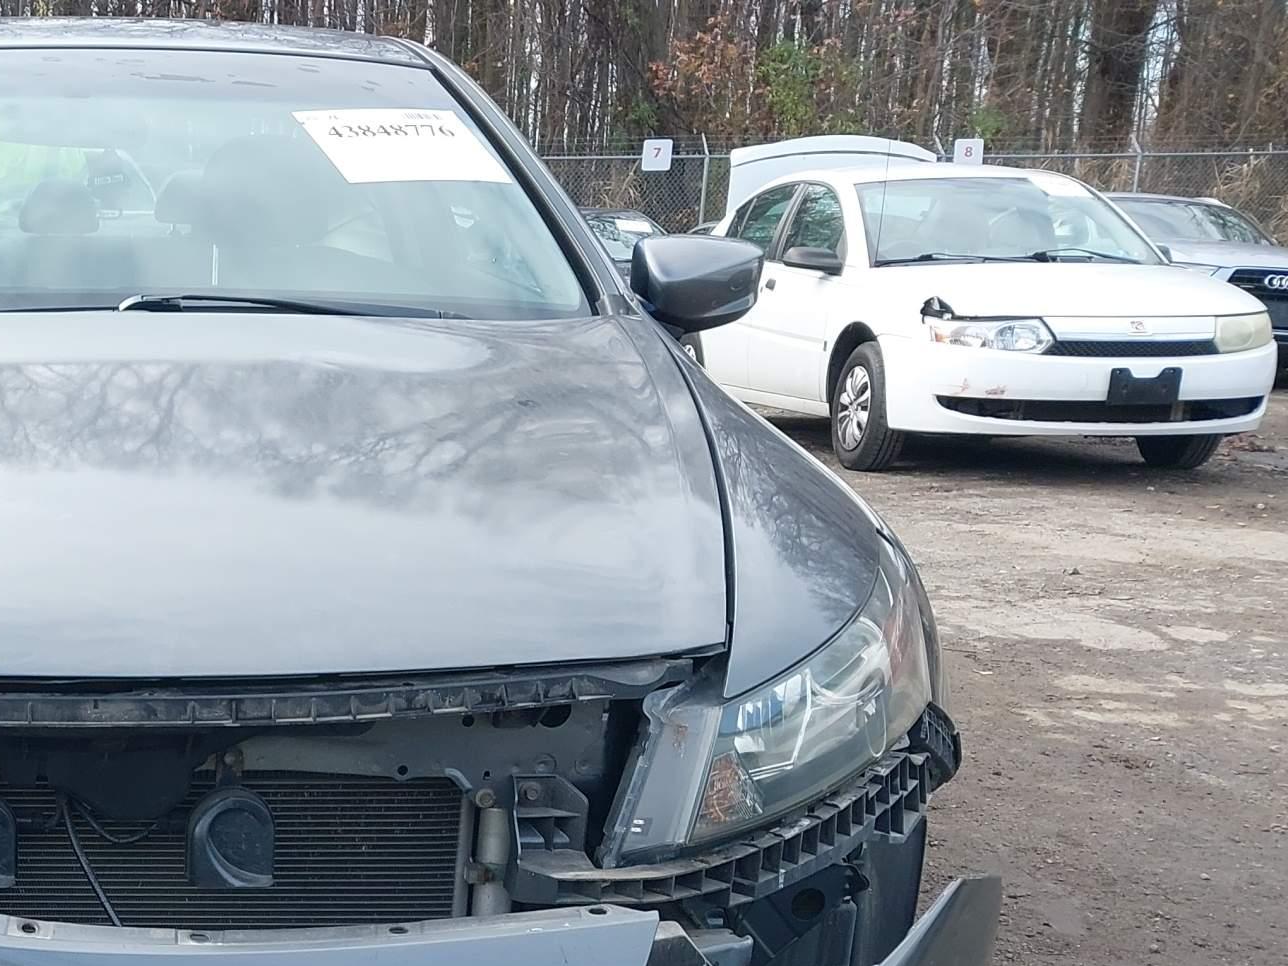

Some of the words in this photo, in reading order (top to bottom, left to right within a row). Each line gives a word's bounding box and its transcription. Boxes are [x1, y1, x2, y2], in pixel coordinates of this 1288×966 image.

[328, 124, 455, 138] 43848776
[653, 148, 662, 158] 7
[964, 146, 973, 157] 8
